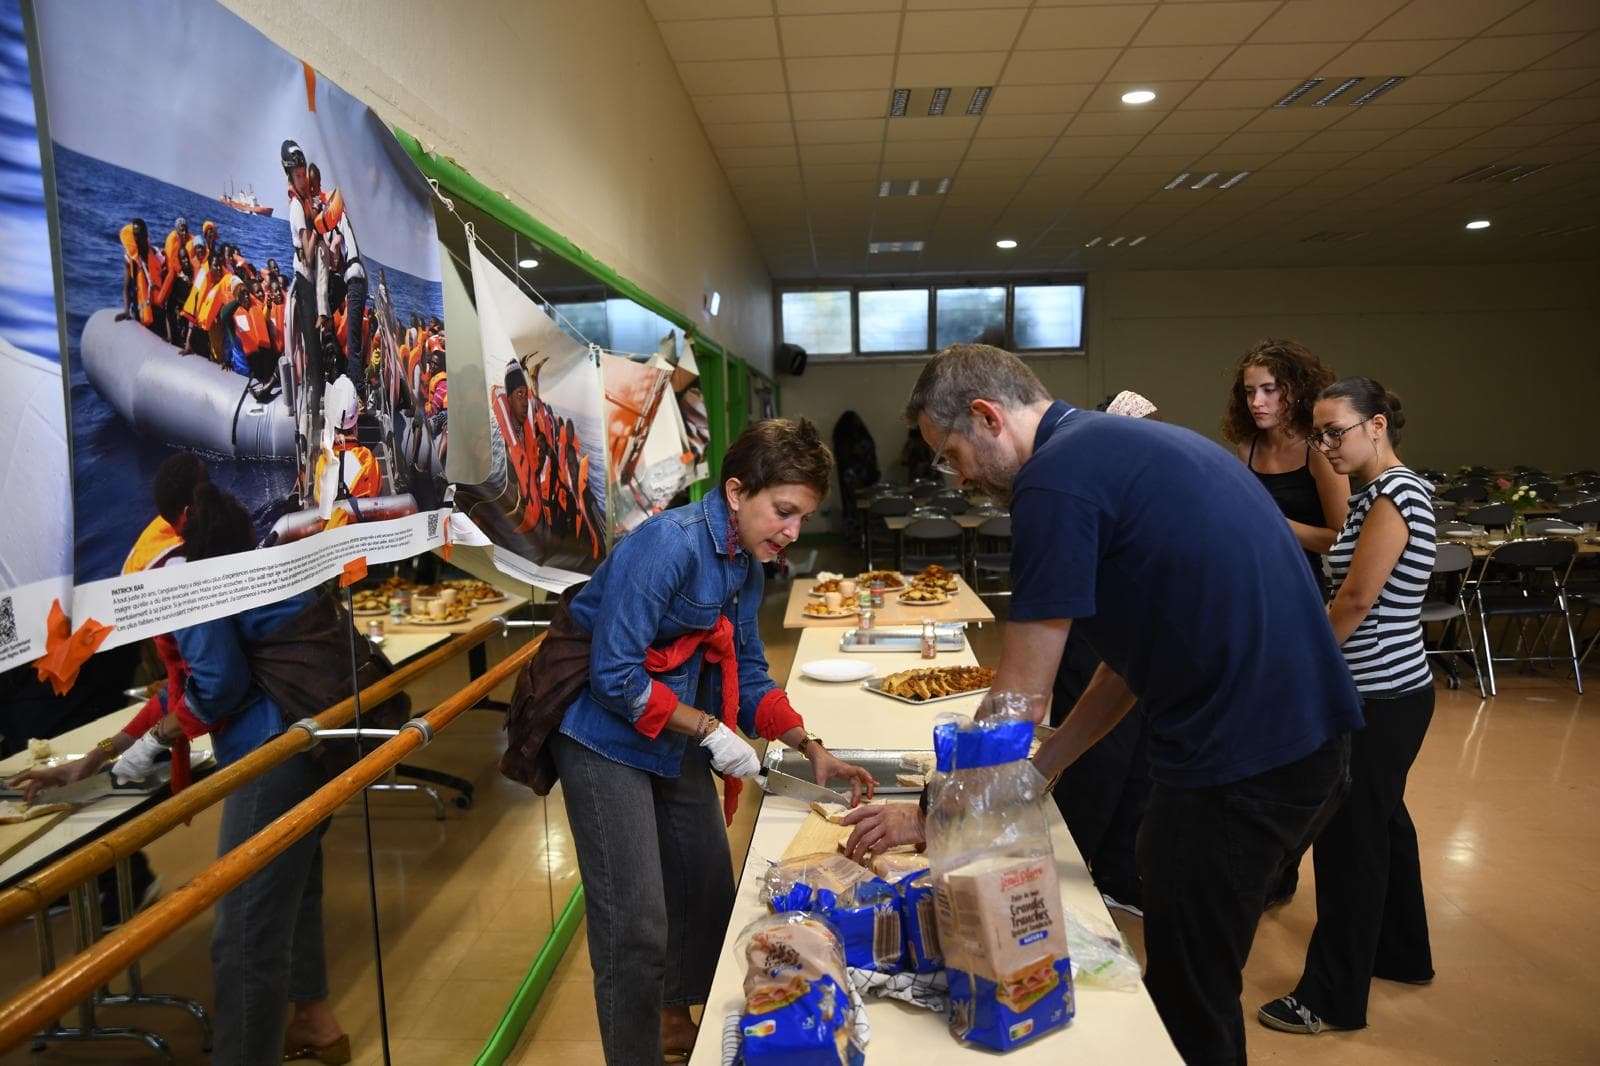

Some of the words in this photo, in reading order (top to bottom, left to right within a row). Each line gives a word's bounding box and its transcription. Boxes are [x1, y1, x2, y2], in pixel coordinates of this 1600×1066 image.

[111, 586, 133, 596] PATRICK
[1010, 898, 1045, 916] Grandes
[1011, 909, 1049, 928] Tranches
